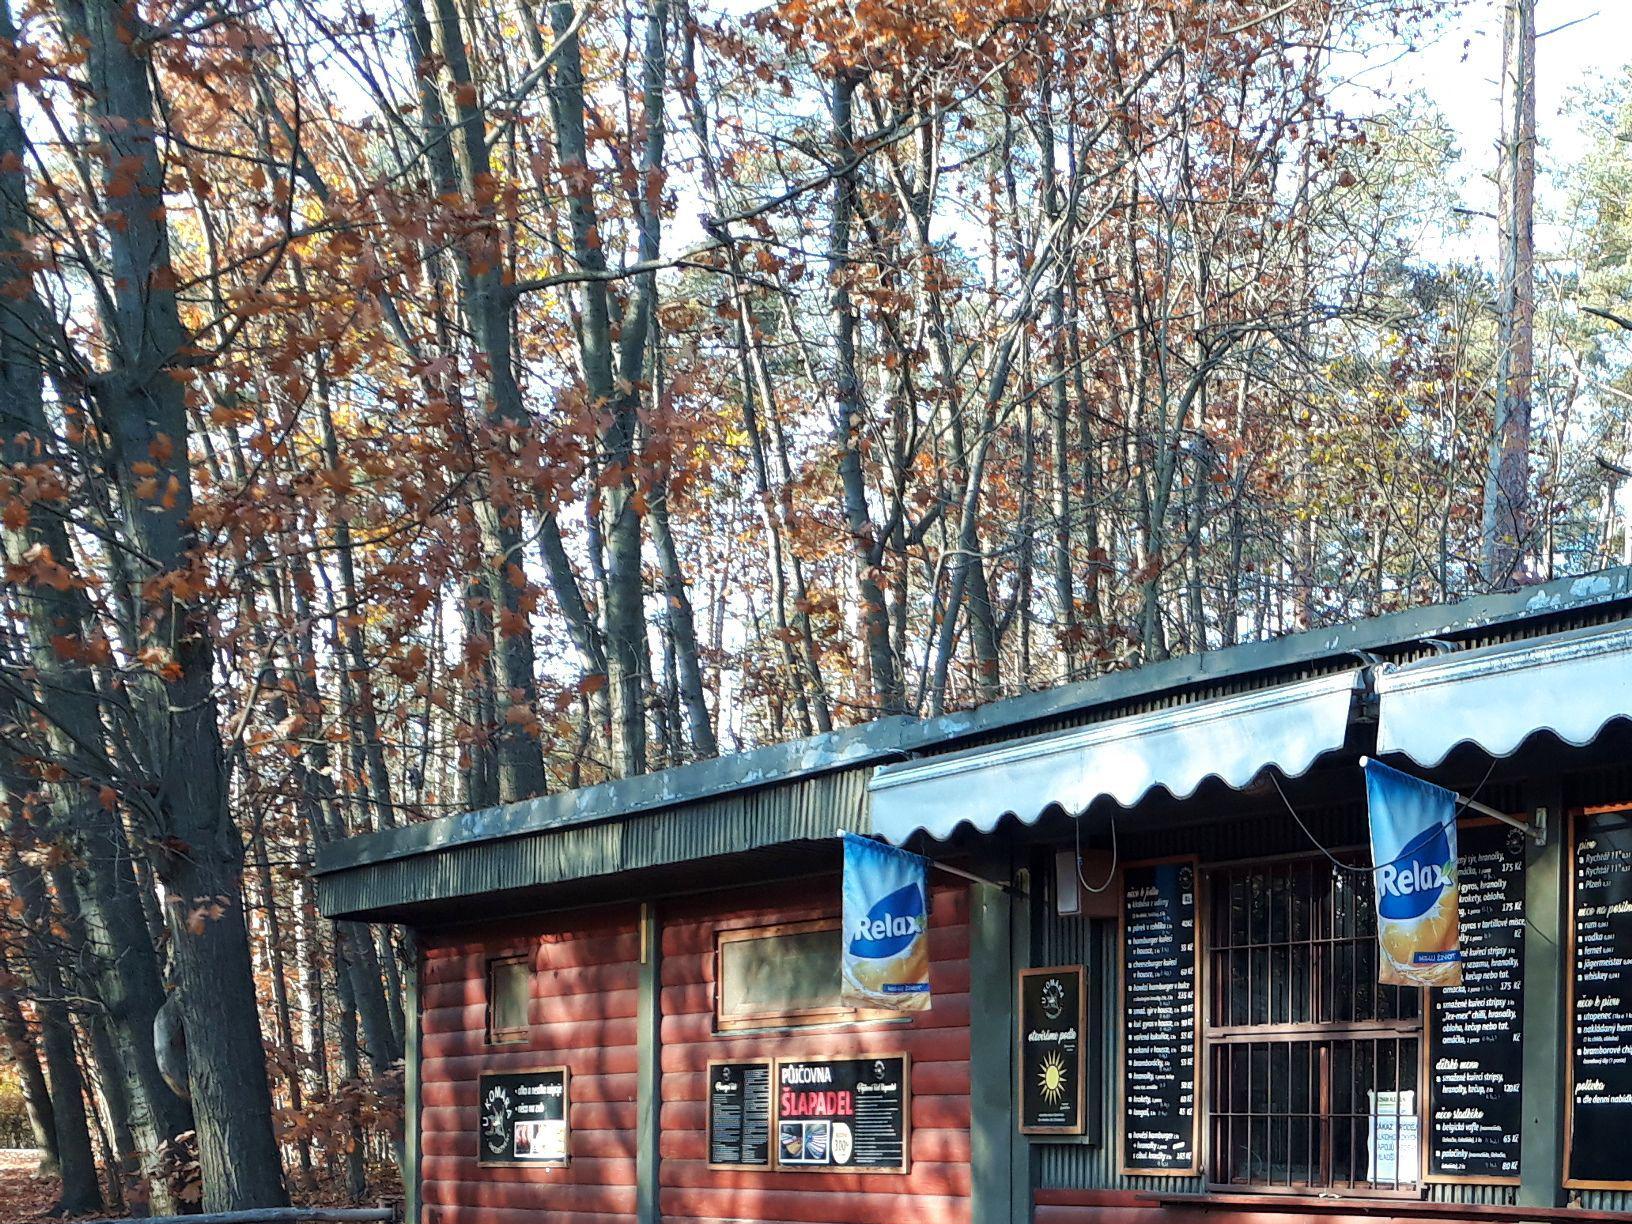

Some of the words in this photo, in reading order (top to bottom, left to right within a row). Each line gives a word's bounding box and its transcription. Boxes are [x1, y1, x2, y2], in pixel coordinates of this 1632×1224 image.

[1577, 840, 1597, 855] pivo
[1502, 863, 1514, 872] 175
[1514, 861, 1522, 870] Kč
[1380, 859, 1453, 897] Relax
[1585, 879, 1602, 889] Plzeň
[1502, 902, 1514, 912] 175
[1514, 901, 1522, 910] Kč
[1596, 906, 1606, 914] na
[854, 912, 922, 941] Relax
[1514, 929, 1522, 938] Kč
[1584, 932, 1603, 942] vodka
[1500, 982, 1512, 990] 175
[1513, 980, 1521, 990] Kč
[1513, 1033, 1521, 1042] Kč
[781, 1064, 832, 1084] PŮJČOVNA
[484, 1086, 512, 1119] KOMÁRA
[781, 1087, 853, 1117] ŠLAPADEL
[1512, 1134, 1519, 1143] Kč
[1511, 1161, 1518, 1170] Kč
